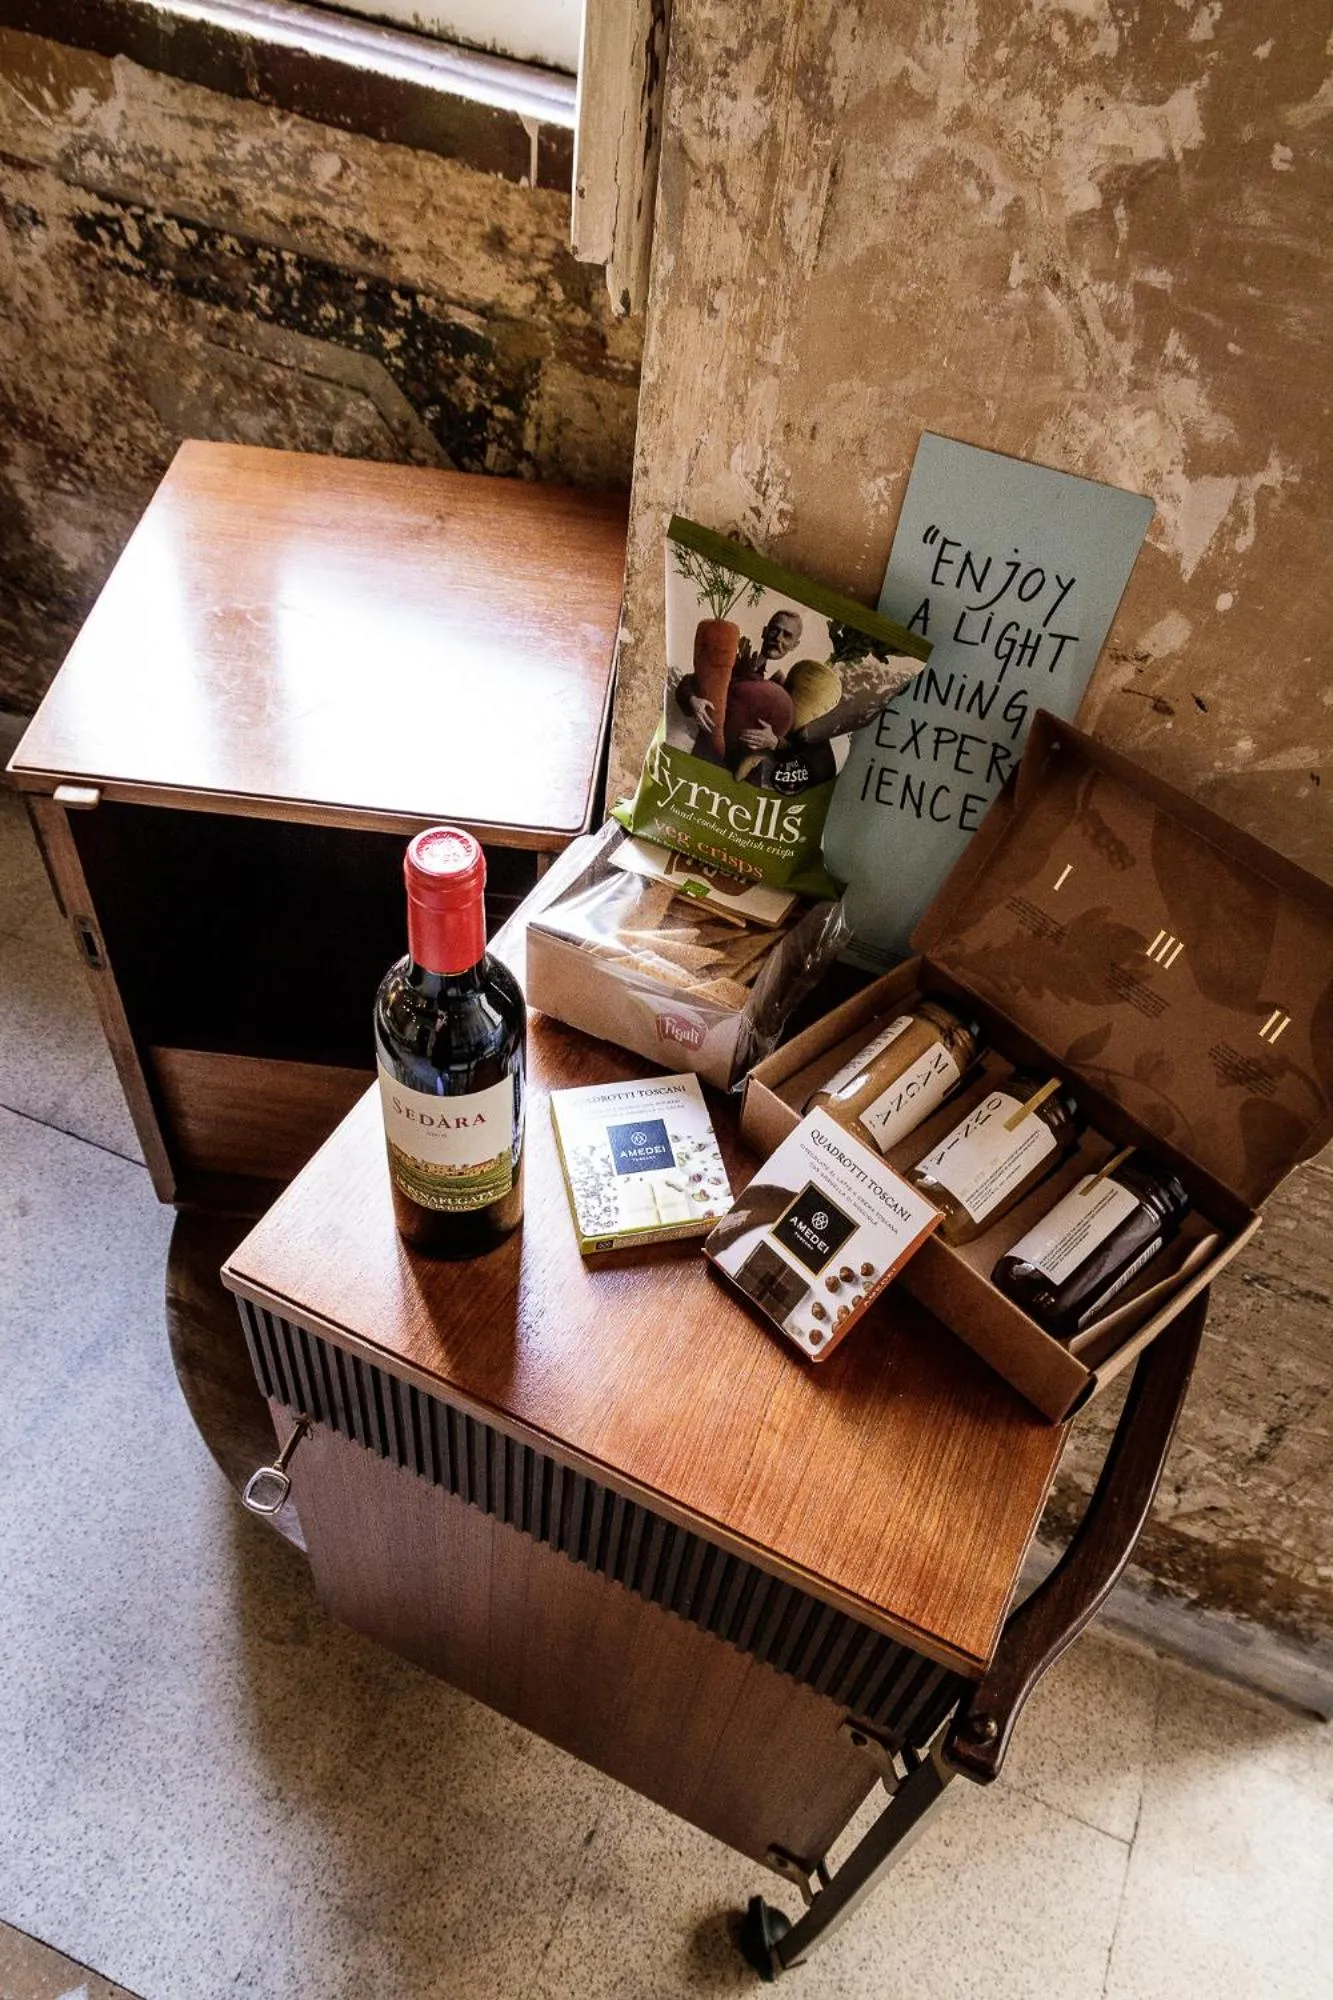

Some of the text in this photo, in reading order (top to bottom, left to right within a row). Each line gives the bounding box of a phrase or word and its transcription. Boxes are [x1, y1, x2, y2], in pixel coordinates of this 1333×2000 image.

[906, 598, 930, 636] A
[774, 767, 809, 783] taste
[654, 817, 691, 848] veg
[697, 841, 764, 879] crisps
[670, 804, 795, 860] hand-cooked English crisps
[619, 1145, 666, 1159] AMEDEI
[811, 1129, 912, 1222] QUADROTTI TOSCANI
[789, 1216, 829, 1254] AMEDEI
